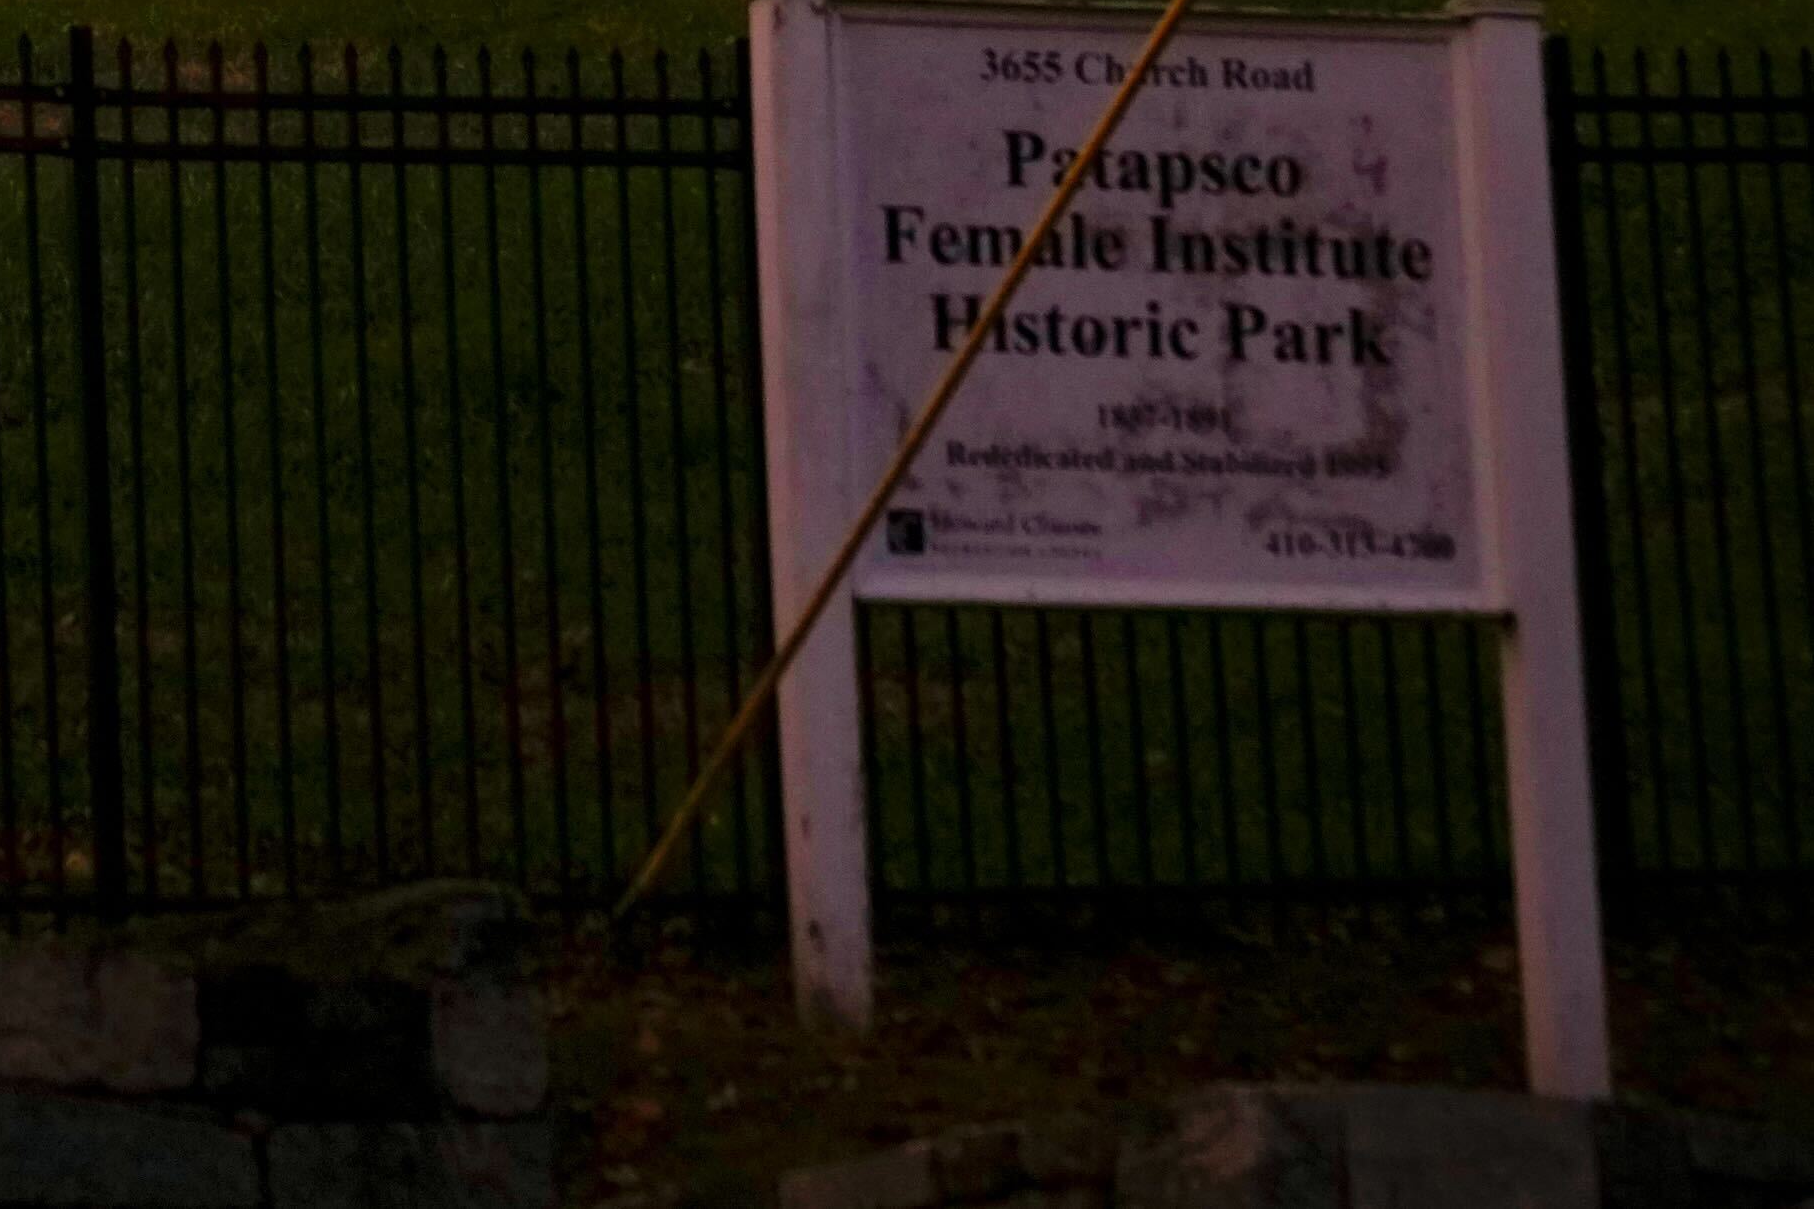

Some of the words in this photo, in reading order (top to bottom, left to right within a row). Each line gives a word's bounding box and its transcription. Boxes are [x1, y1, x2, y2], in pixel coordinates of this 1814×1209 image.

[980, 47, 1063, 84] 3655
[1075, 51, 1208, 88] Chrch
[1221, 57, 1316, 92] Road
[1002, 128, 1302, 210] Patapsco
[882, 204, 1126, 271] Female
[1150, 213, 1433, 283] Institute
[1225, 300, 1391, 367] Park
